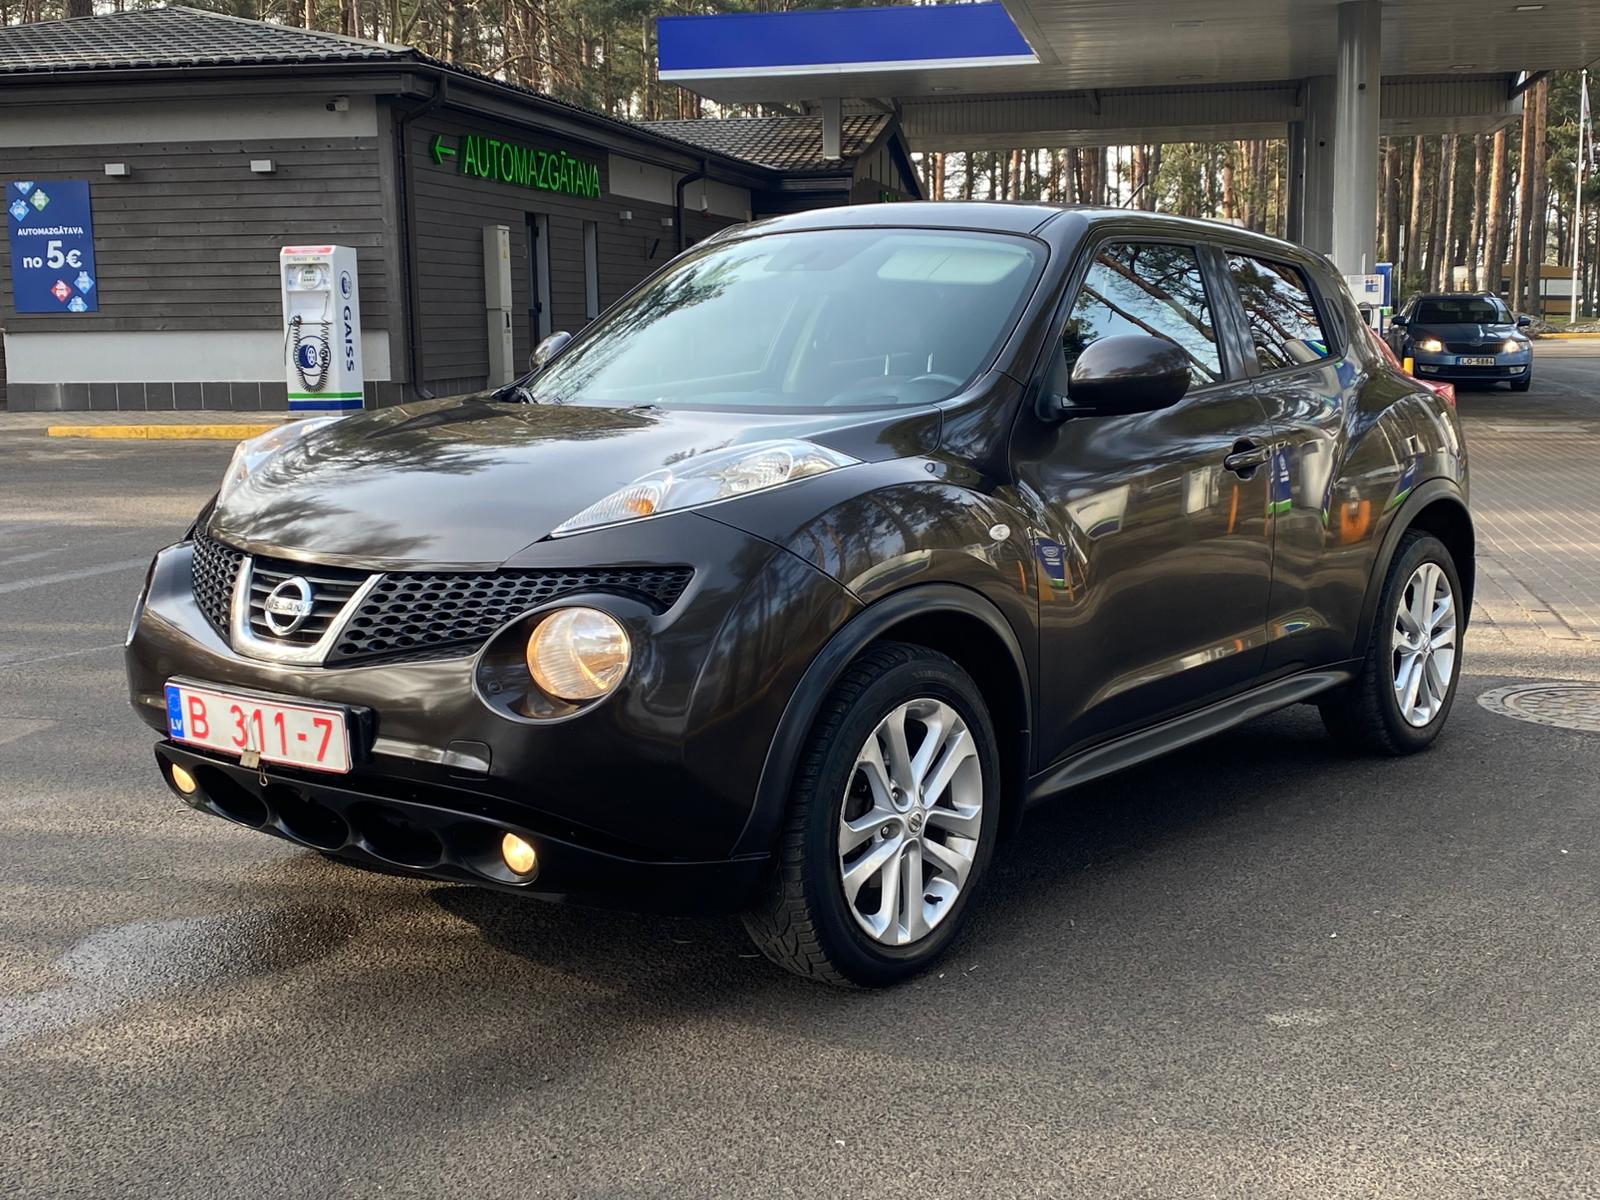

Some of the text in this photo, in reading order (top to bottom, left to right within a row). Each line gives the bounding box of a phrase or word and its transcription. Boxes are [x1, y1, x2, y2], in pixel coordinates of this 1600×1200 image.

[464, 135, 601, 198] AUTOMAZGĀTAVA
[17, 226, 84, 236] AUTOMAZGĀTAVA
[23, 240, 82, 269] no 5€
[343, 305, 355, 372] GAISS
[170, 717, 183, 730] LV
[187, 696, 333, 762] B 311-7
